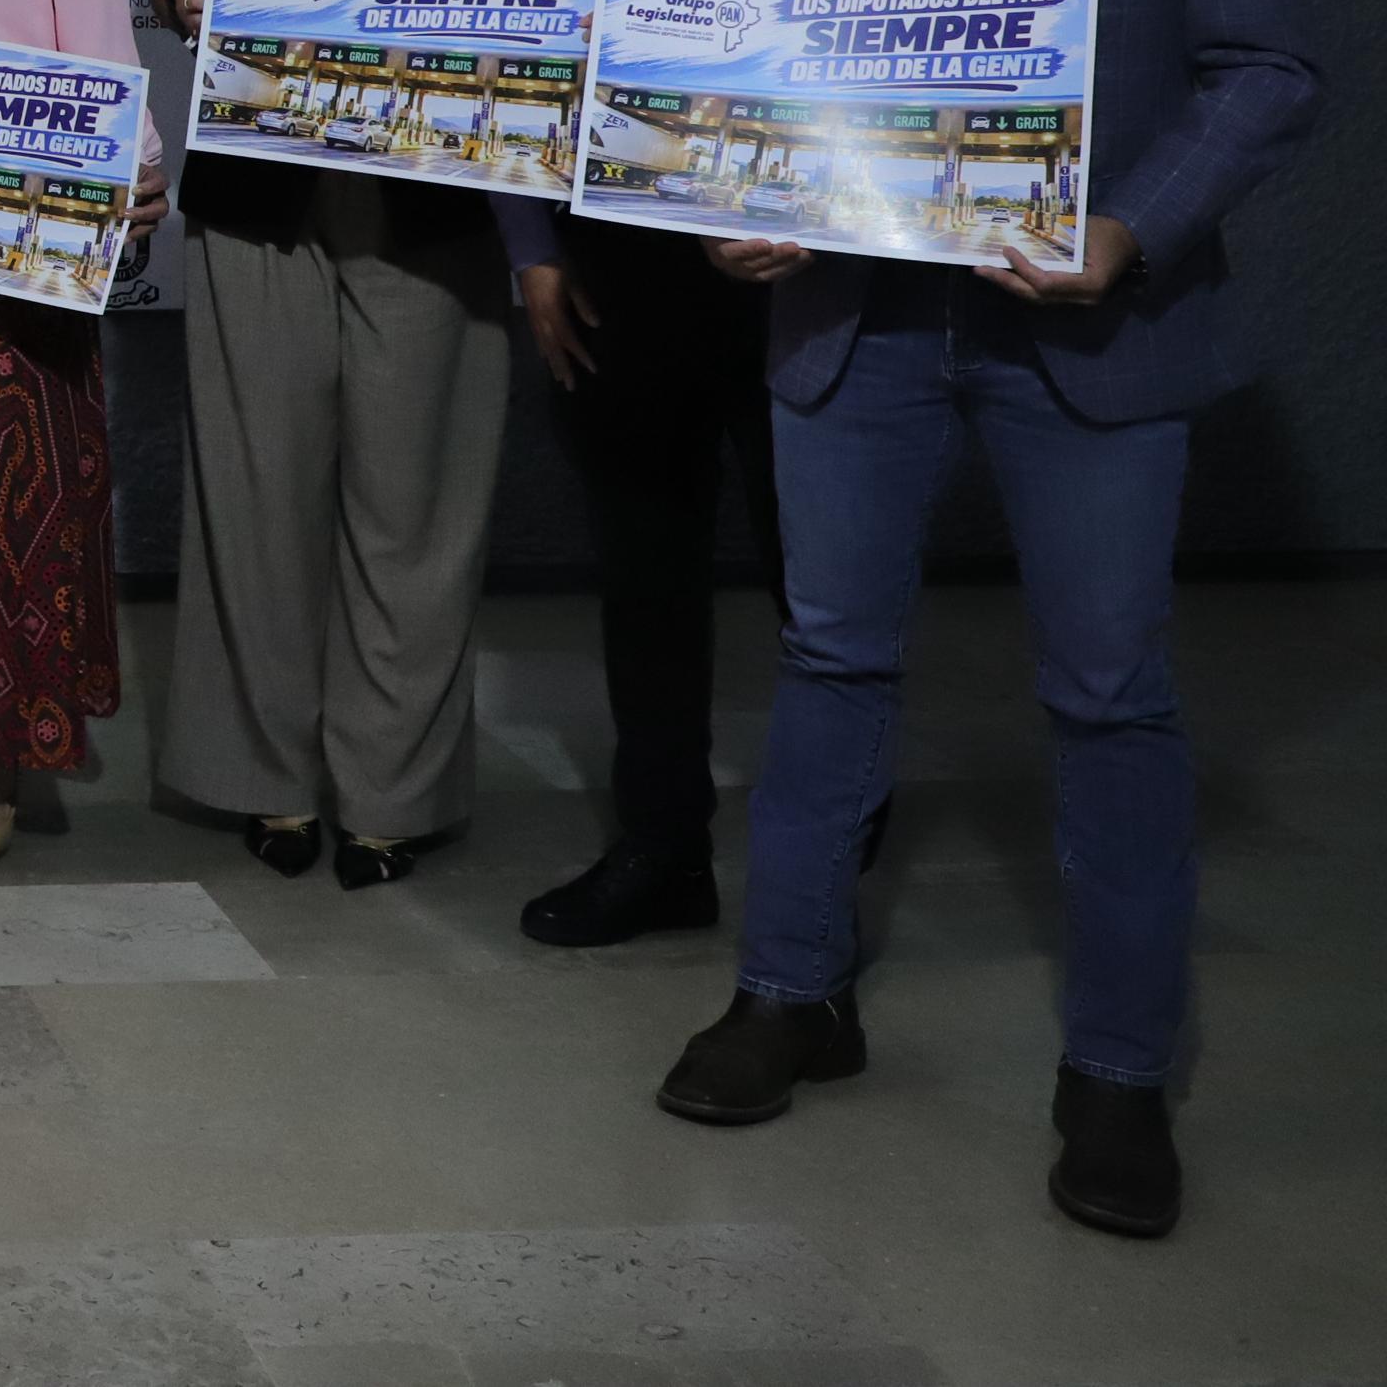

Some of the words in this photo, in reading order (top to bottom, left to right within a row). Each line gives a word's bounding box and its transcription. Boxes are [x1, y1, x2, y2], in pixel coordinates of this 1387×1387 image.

[626, 3, 714, 27] Legislativo
[718, 4, 742, 24] PAN
[802, 11, 1035, 57] SIEMPRE
[790, 59, 822, 82] DE
[826, 57, 891, 82] LADO
[895, 57, 927, 80] DE
[933, 56, 963, 79] LA
[968, 51, 1052, 79] GENTE
[647, 94, 680, 111] GRATIS
[771, 106, 809, 122] GRATIS
[893, 114, 930, 128] GRATIS
[1015, 116, 1057, 131] GRATIS
